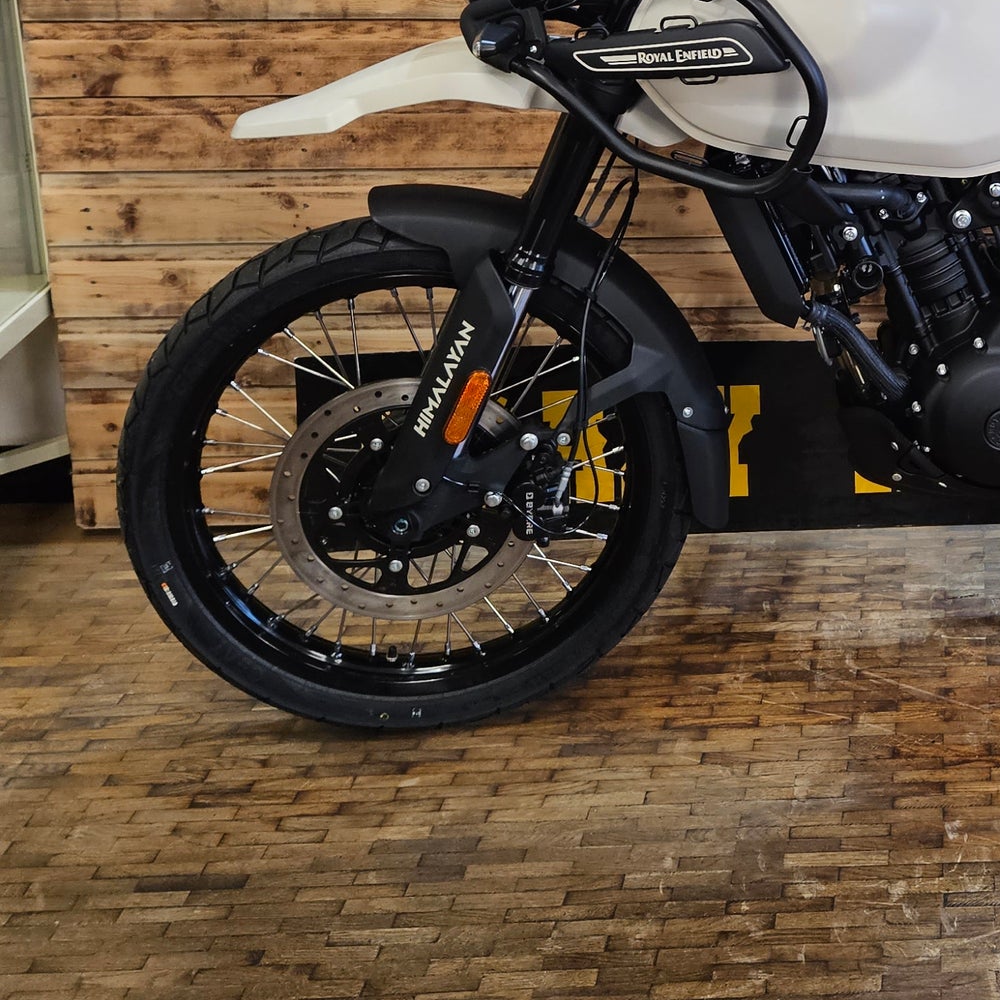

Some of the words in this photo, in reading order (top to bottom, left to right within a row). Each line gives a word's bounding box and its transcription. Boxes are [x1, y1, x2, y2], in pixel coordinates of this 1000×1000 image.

[637, 51, 675, 65] ROYAL
[675, 48, 723, 63] ENFIELD
[413, 320, 476, 438] HIMALAYAN
